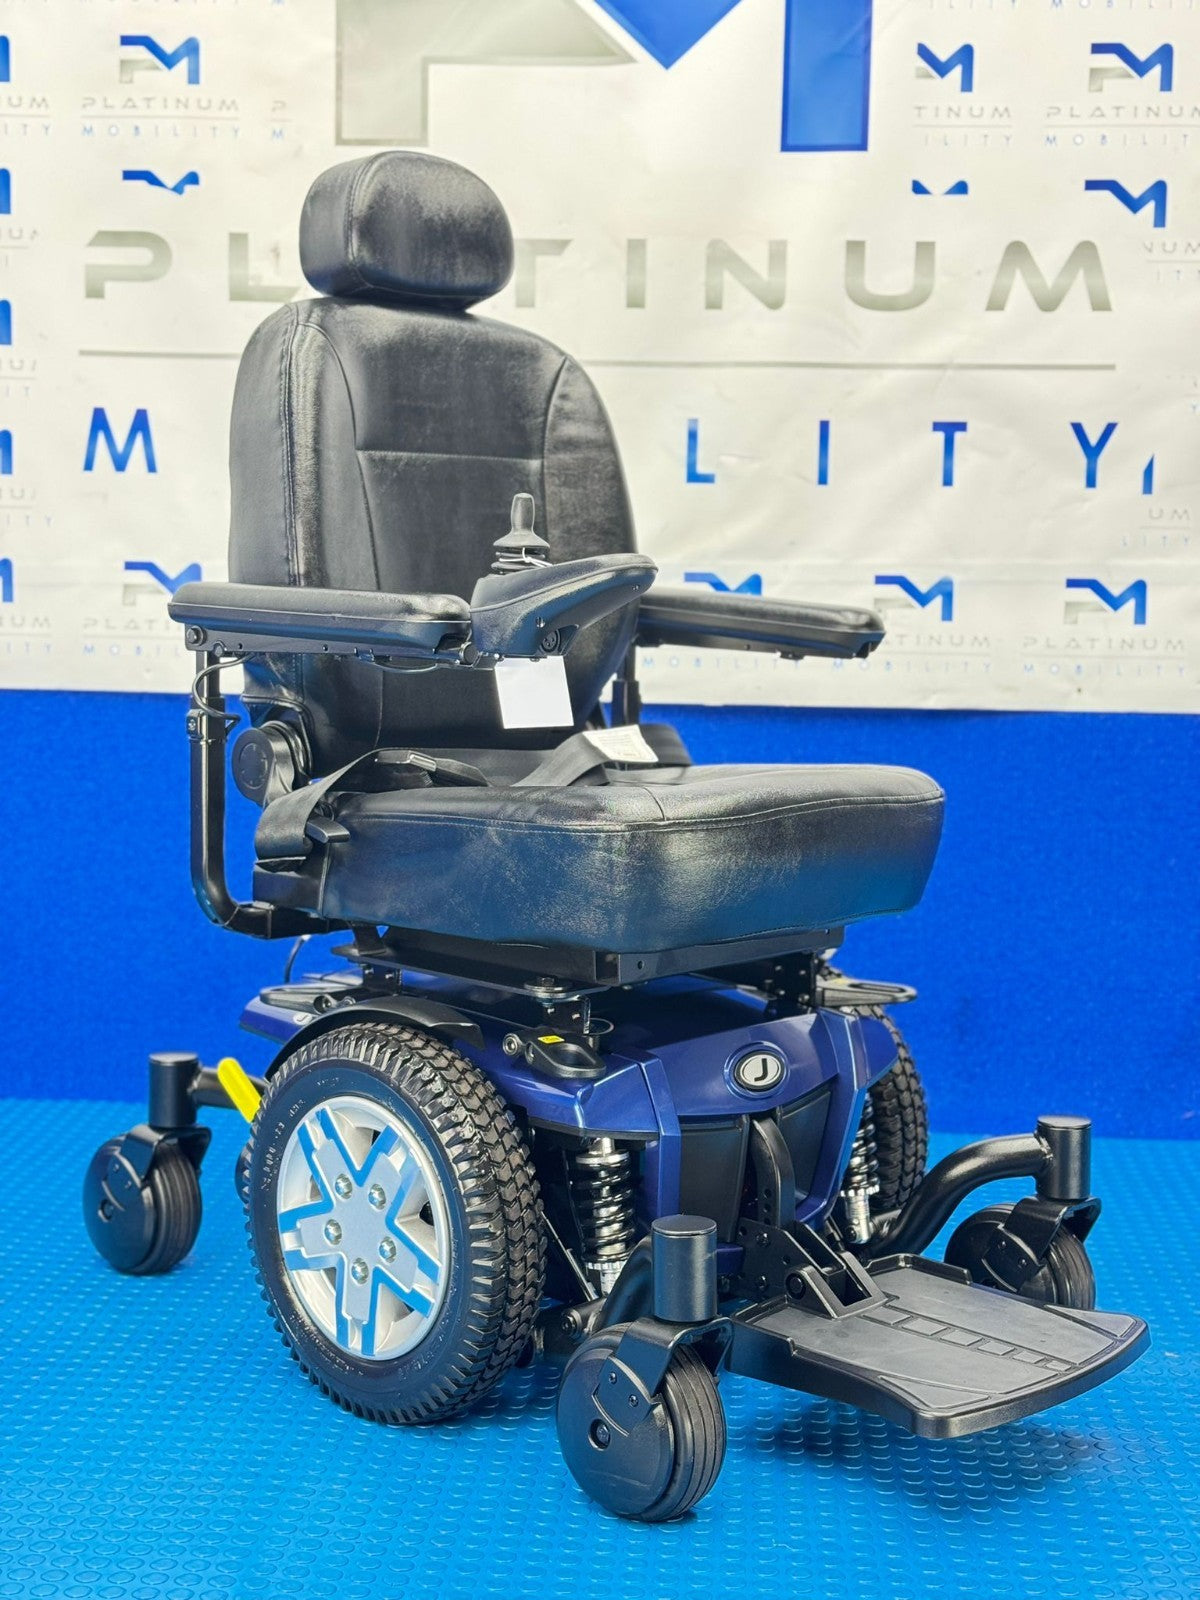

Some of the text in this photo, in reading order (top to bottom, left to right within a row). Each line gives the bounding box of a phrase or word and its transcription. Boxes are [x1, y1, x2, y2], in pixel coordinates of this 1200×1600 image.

[81, 97, 239, 112] PLATINUM
[81, 124, 241, 138] MOBILITY
[1045, 134, 1189, 147] MOBILIT
[85, 230, 1113, 313] PLTINUM
[83, 407, 1120, 489] MLITY
[1022, 636, 1186, 651] PLATINUM
[1023, 662, 1187, 678] MOBILITY
